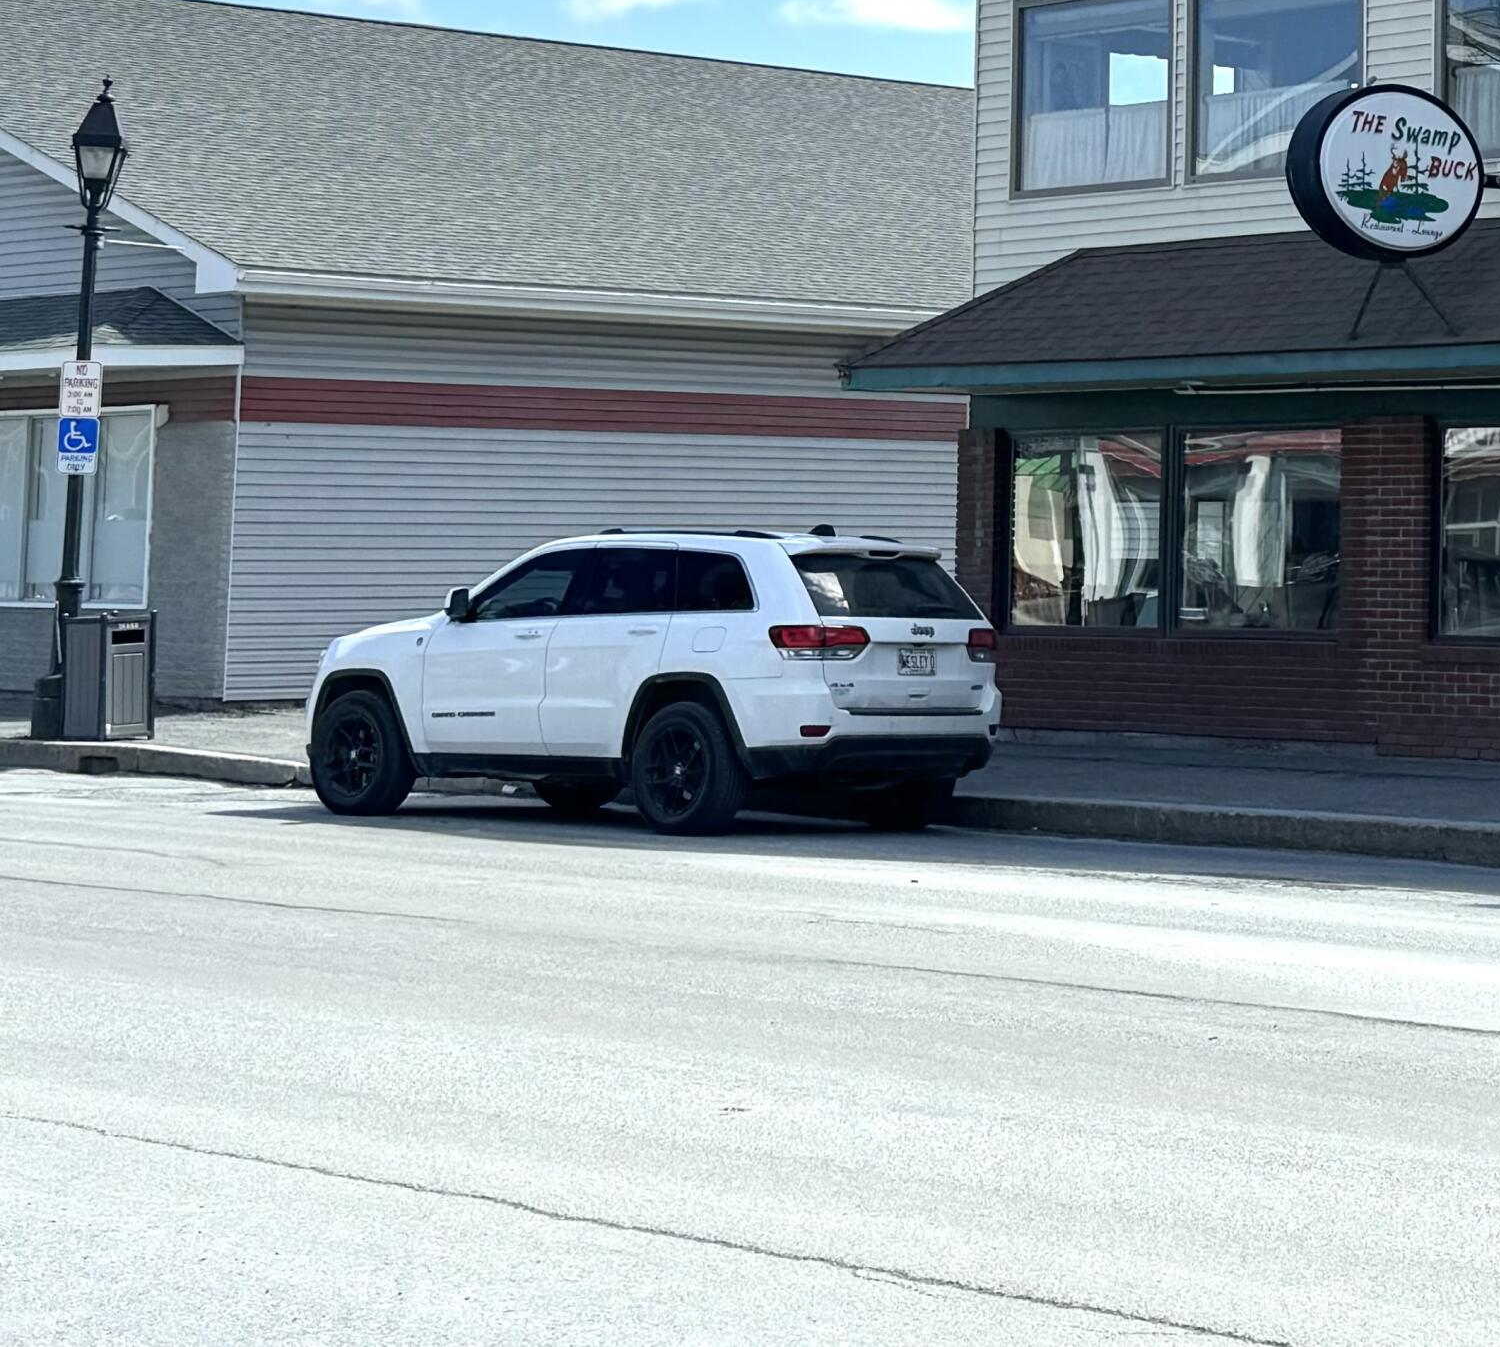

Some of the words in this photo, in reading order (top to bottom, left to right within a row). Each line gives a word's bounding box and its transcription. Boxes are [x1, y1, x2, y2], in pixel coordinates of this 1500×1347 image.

[1351, 110, 1387, 134] THE
[1392, 116, 1461, 155] Swamp
[1428, 156, 1478, 181] BUCK
[76, 364, 88, 376] NO
[64, 377, 98, 389] PARKING
